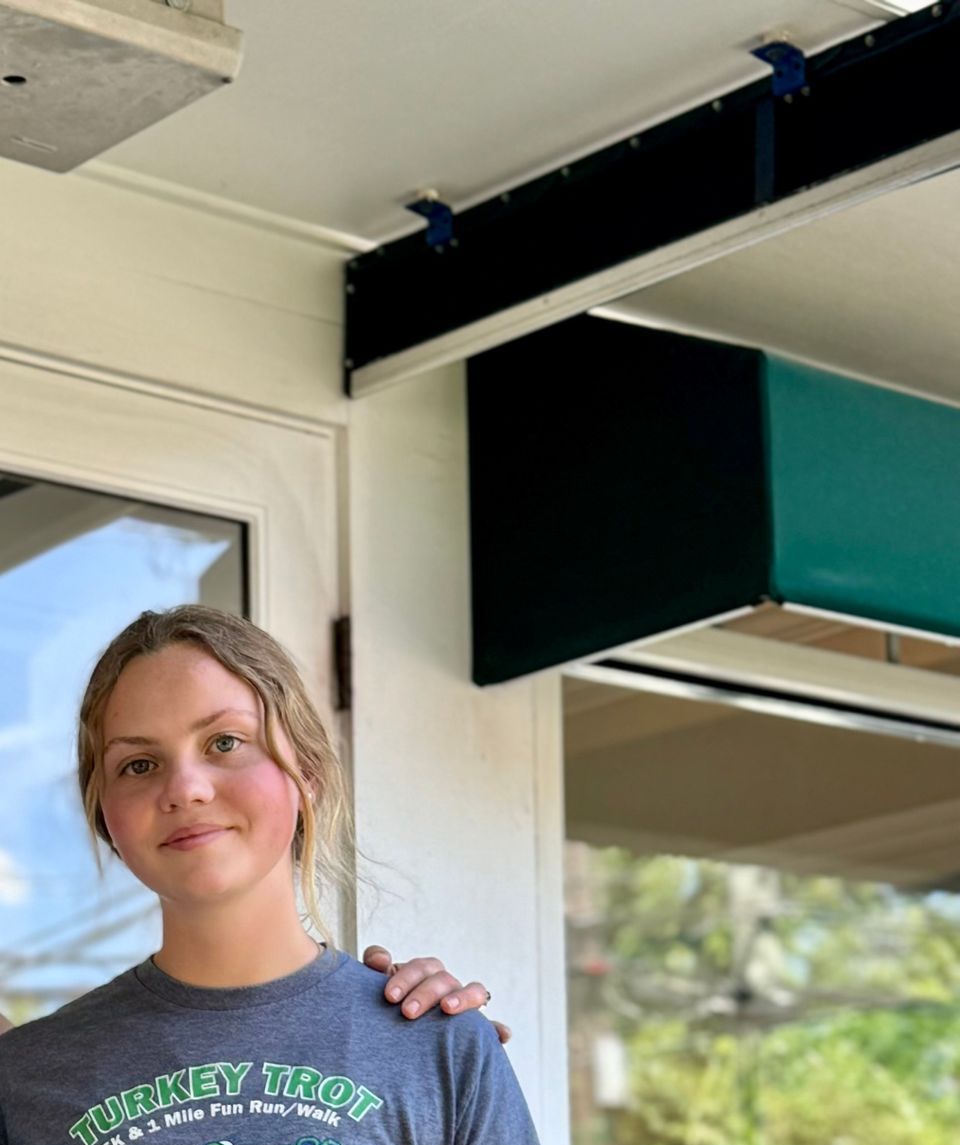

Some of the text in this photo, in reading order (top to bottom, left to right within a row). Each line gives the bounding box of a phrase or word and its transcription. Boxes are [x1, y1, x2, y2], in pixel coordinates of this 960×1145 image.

[262, 1062, 383, 1122] TROT
[128, 1126, 144, 1140] &
[147, 1119, 161, 1133] 1
[164, 1108, 205, 1128] Mile
[210, 1102, 243, 1117] Fun
[249, 1100, 341, 1127] Run/Walk
